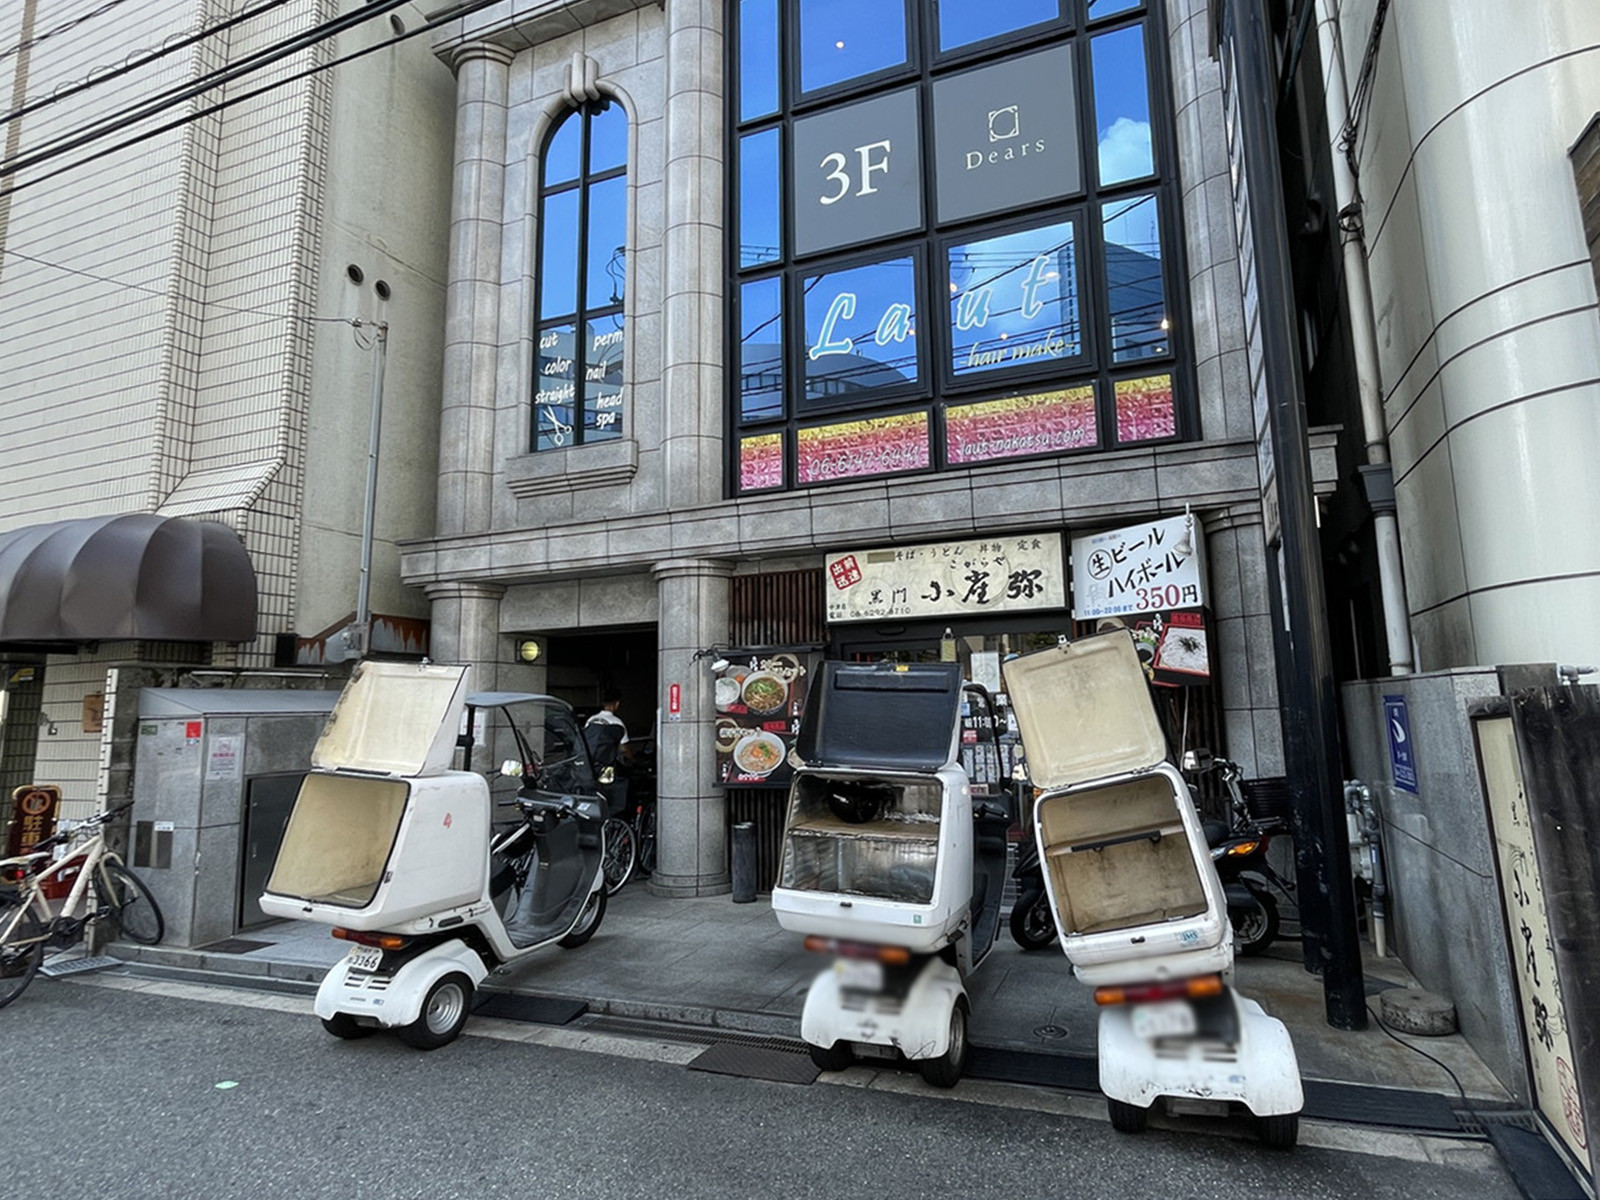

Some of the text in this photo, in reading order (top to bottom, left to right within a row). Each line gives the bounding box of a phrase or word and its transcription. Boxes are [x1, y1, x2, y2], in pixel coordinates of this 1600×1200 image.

[965, 138, 1046, 170] Dears
[819, 140, 891, 205] 3F
[539, 332, 559, 349] cut
[592, 329, 623, 352] perm
[544, 356, 572, 375] color
[585, 360, 606, 381] nail
[534, 383, 576, 404] straight
[596, 386, 624, 409] head
[595, 411, 616, 430] spa
[1107, 551, 1187, 598] ハイボール
[1135, 583, 1199, 611] 350円
